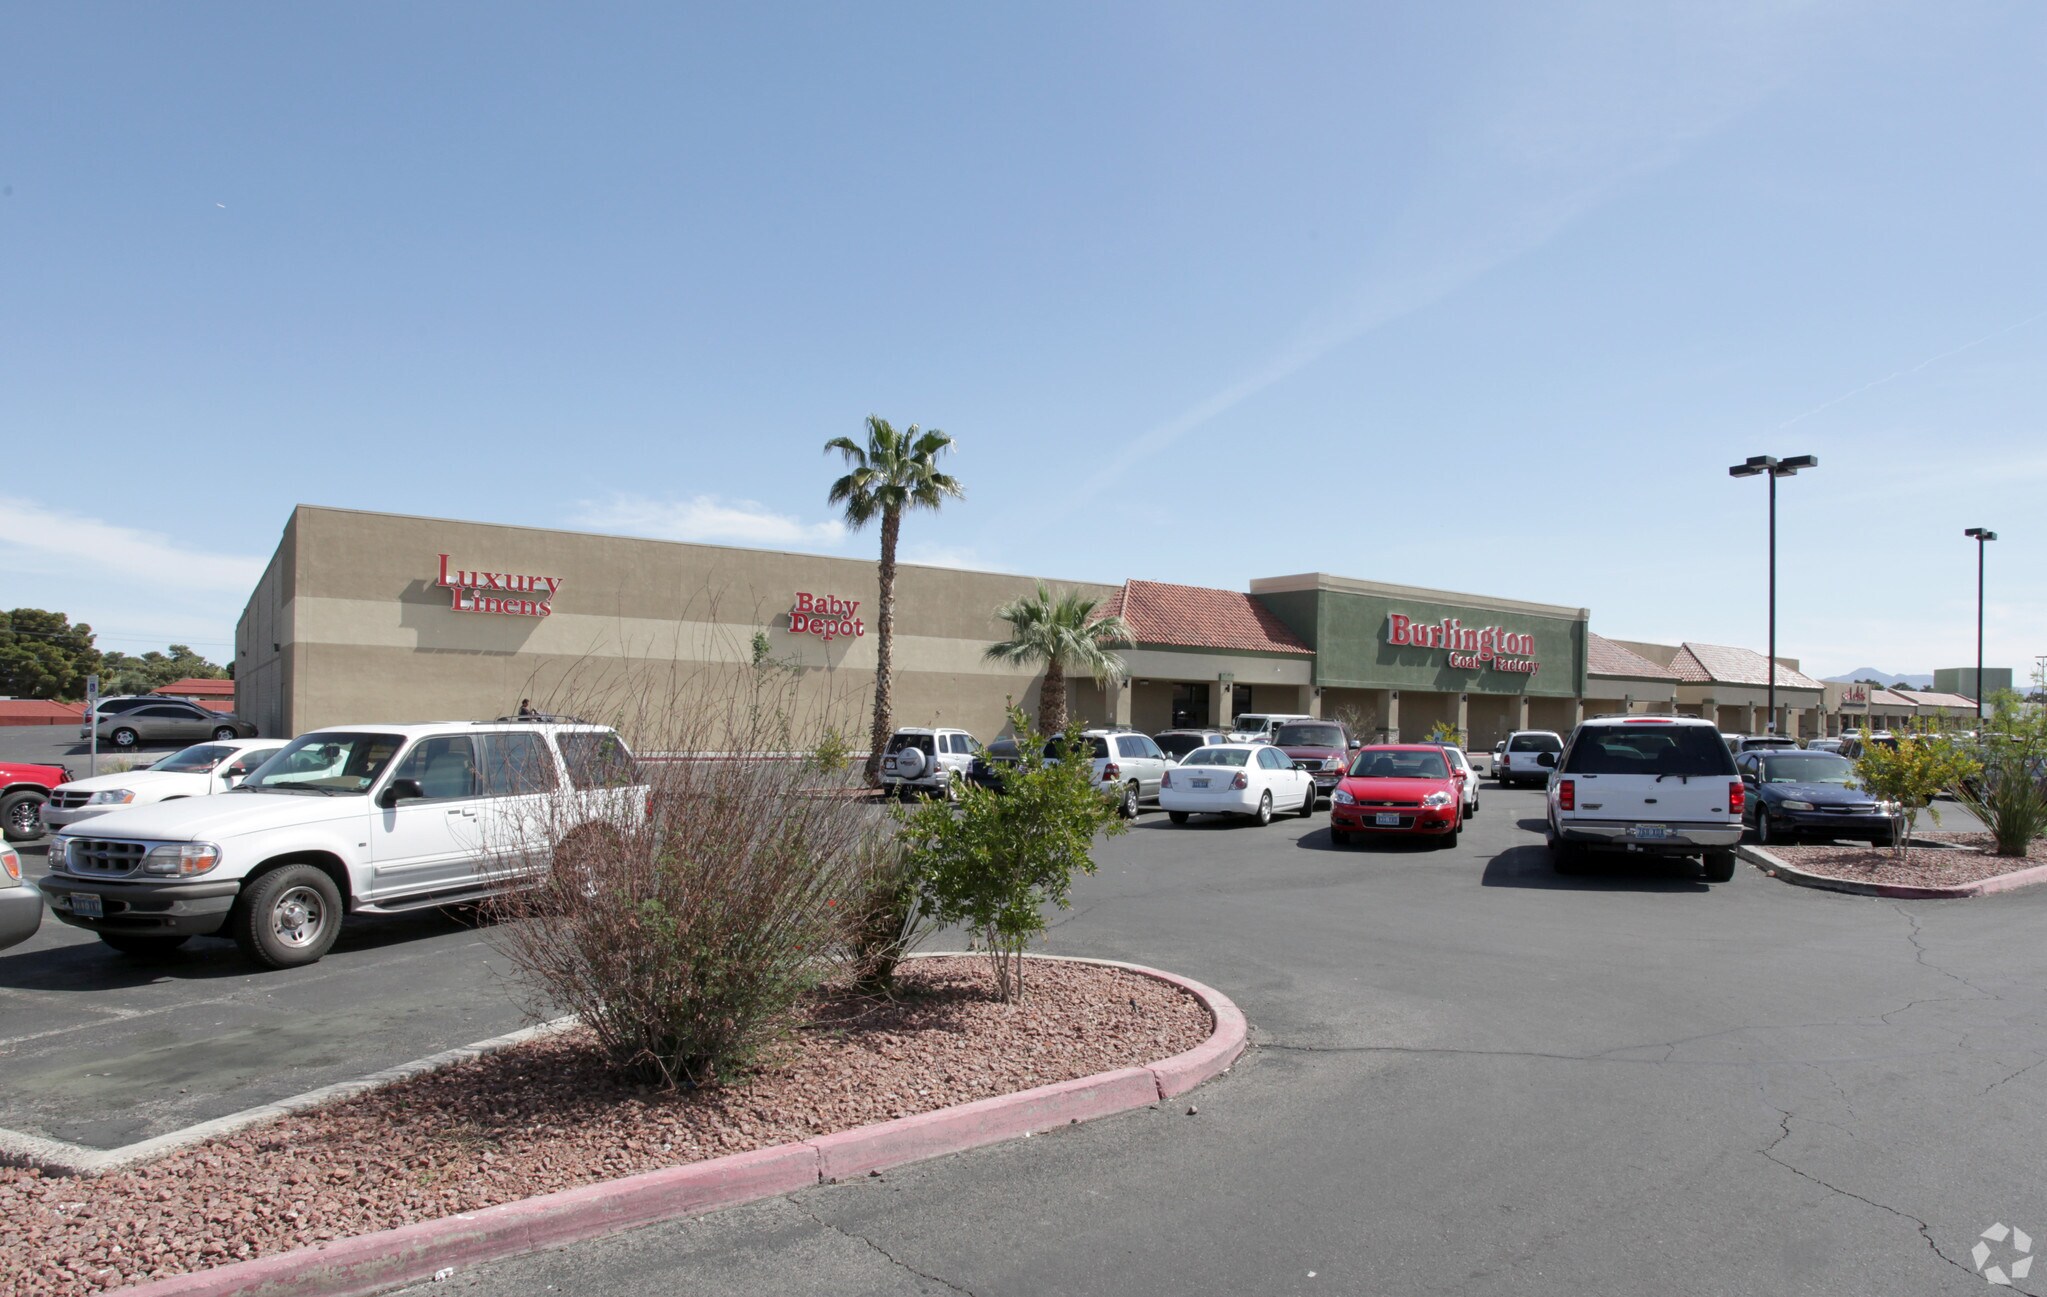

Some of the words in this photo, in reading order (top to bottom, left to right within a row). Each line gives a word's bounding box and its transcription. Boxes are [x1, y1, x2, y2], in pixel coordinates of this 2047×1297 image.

[436, 553, 563, 601] Luxury
[451, 587, 551, 616] Linens
[795, 592, 860, 620] Baby
[788, 612, 864, 640] Depot
[1388, 613, 1535, 661] Burlington
[1449, 651, 1480, 669] Coat
[1493, 655, 1540, 676] Factory
